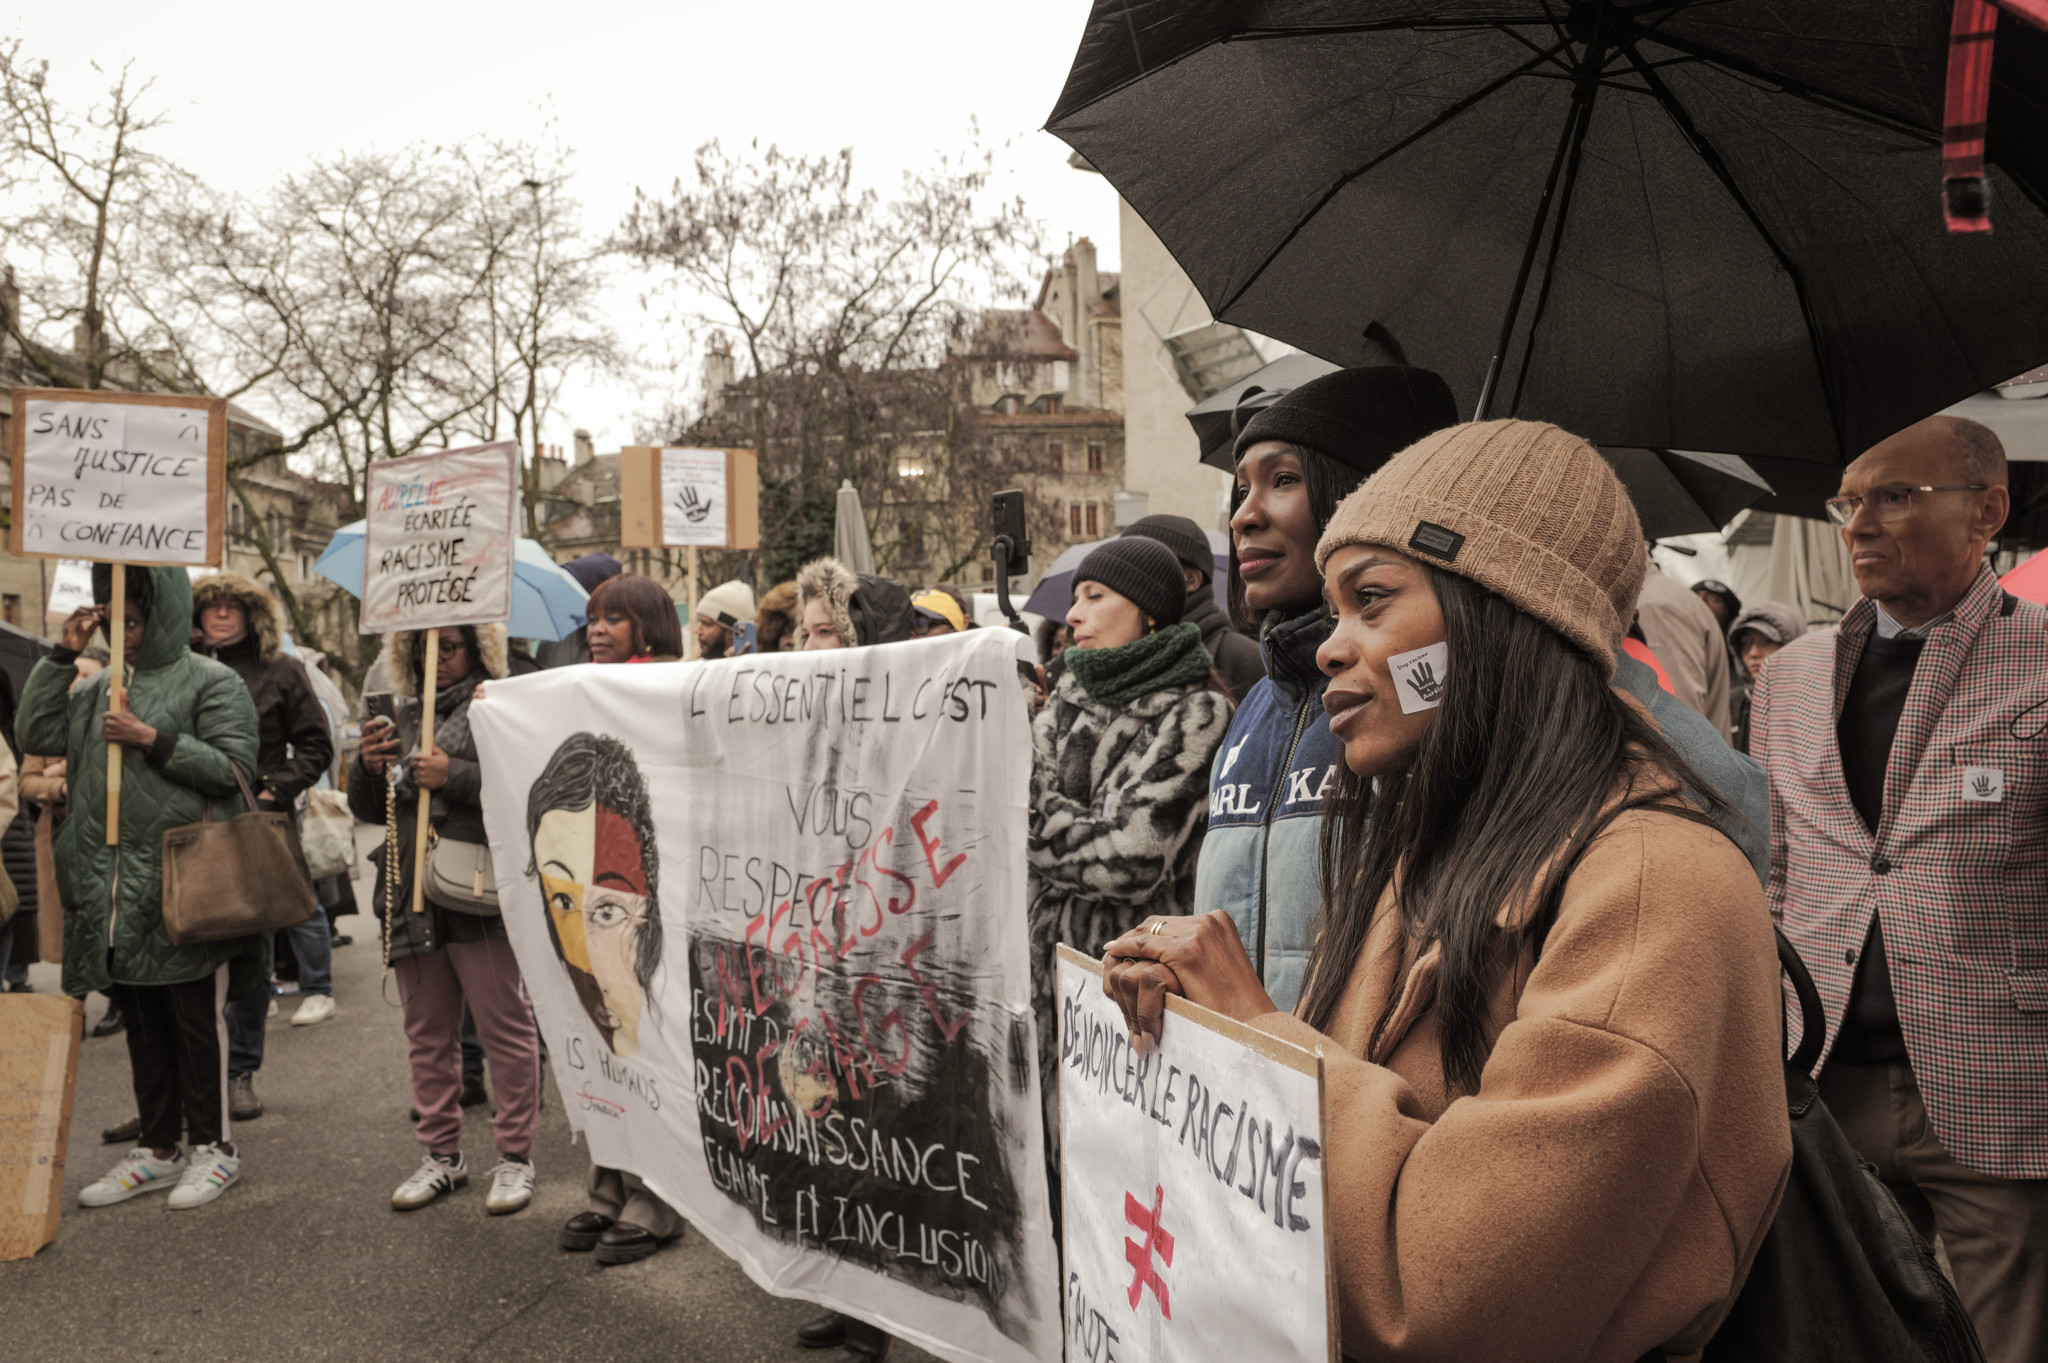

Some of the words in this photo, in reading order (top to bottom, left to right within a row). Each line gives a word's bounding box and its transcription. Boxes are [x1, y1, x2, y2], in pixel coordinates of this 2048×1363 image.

[34, 412, 108, 439] SANS
[74, 446, 198, 480] JUSTICE
[28, 484, 75, 507] PAS
[99, 492, 127, 509] DE
[376, 474, 447, 512] AURÉLIE
[60, 521, 204, 550] CONFIANCE
[379, 537, 465, 574] RACISME
[396, 566, 479, 608] PROTÉGÉ
[786, 780, 872, 850] VOUS
[1061, 976, 1150, 1116] DÉNONCER
[1150, 1052, 1182, 1128] LE
[1178, 1073, 1321, 1233] RACISME
[696, 1058, 989, 1211] RECONNAISSANCE
